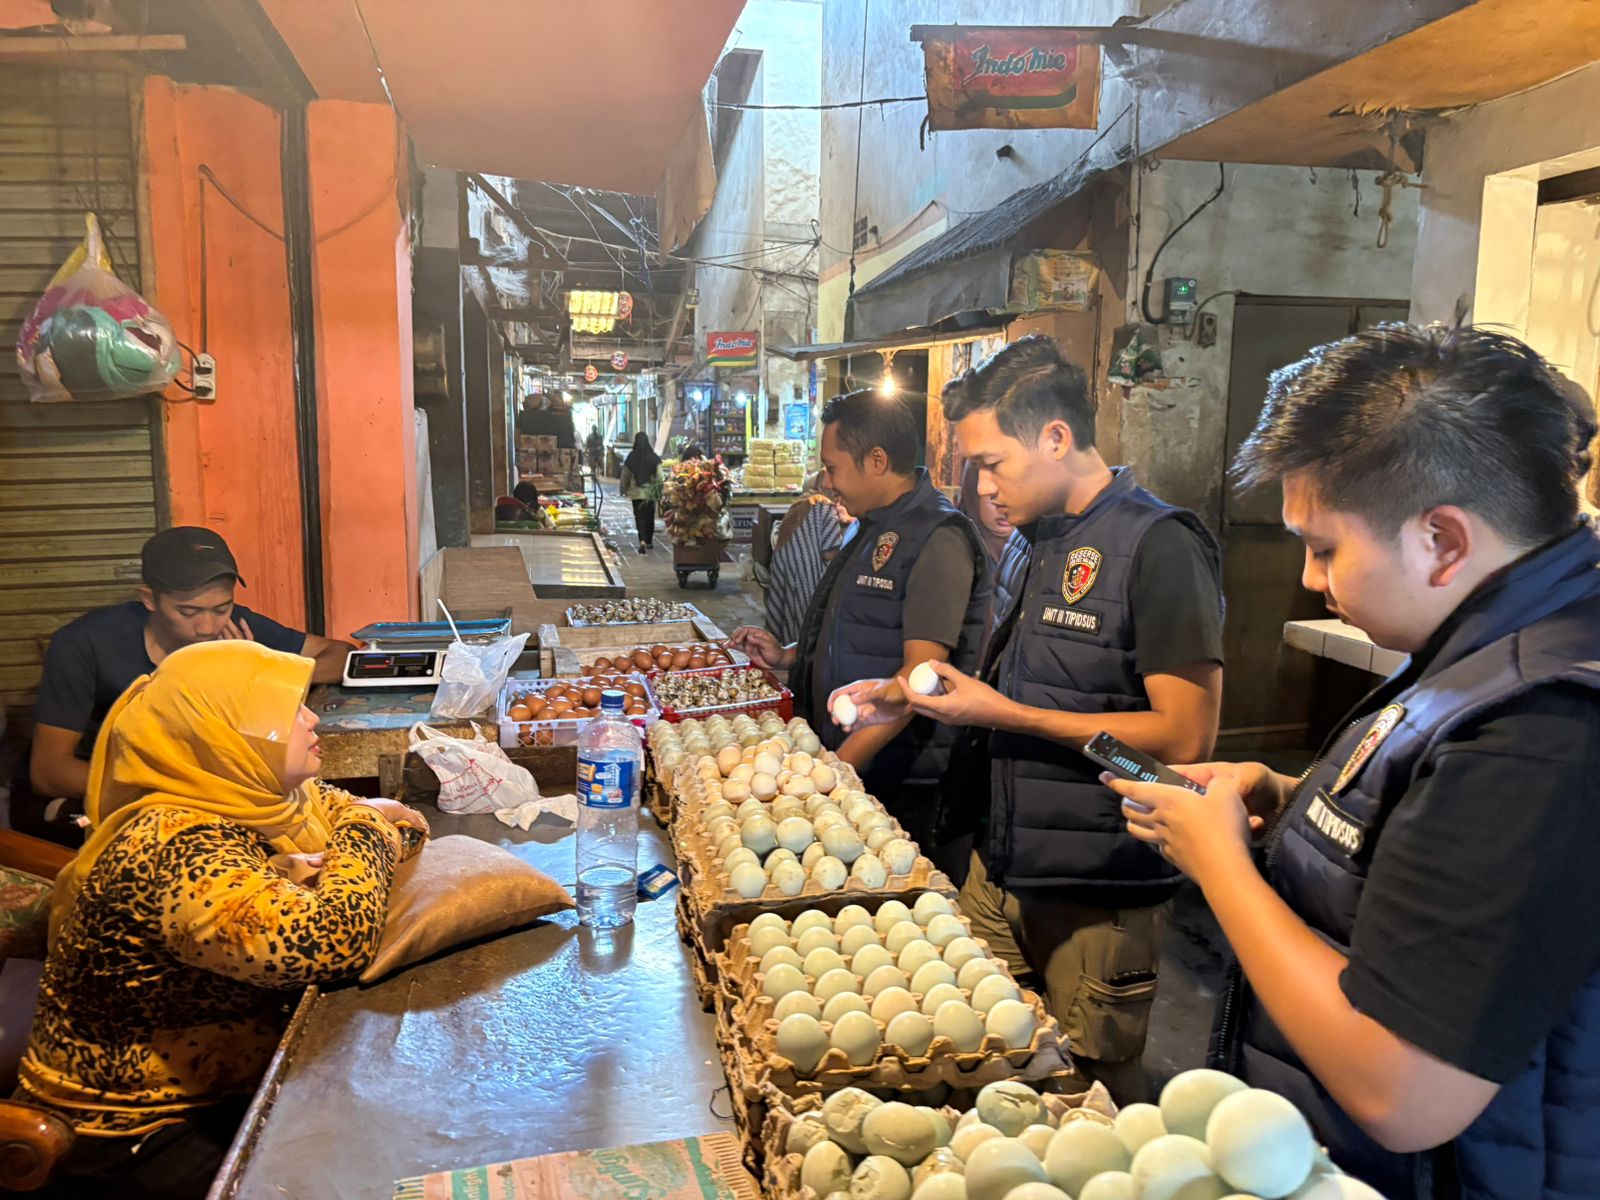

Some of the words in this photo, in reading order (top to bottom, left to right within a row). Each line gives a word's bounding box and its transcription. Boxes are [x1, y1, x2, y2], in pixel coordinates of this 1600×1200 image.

[1070, 549, 1099, 563] RESERSE
[1042, 607, 1058, 622] UNIT
[1065, 611, 1097, 630] TIPIDSUS
